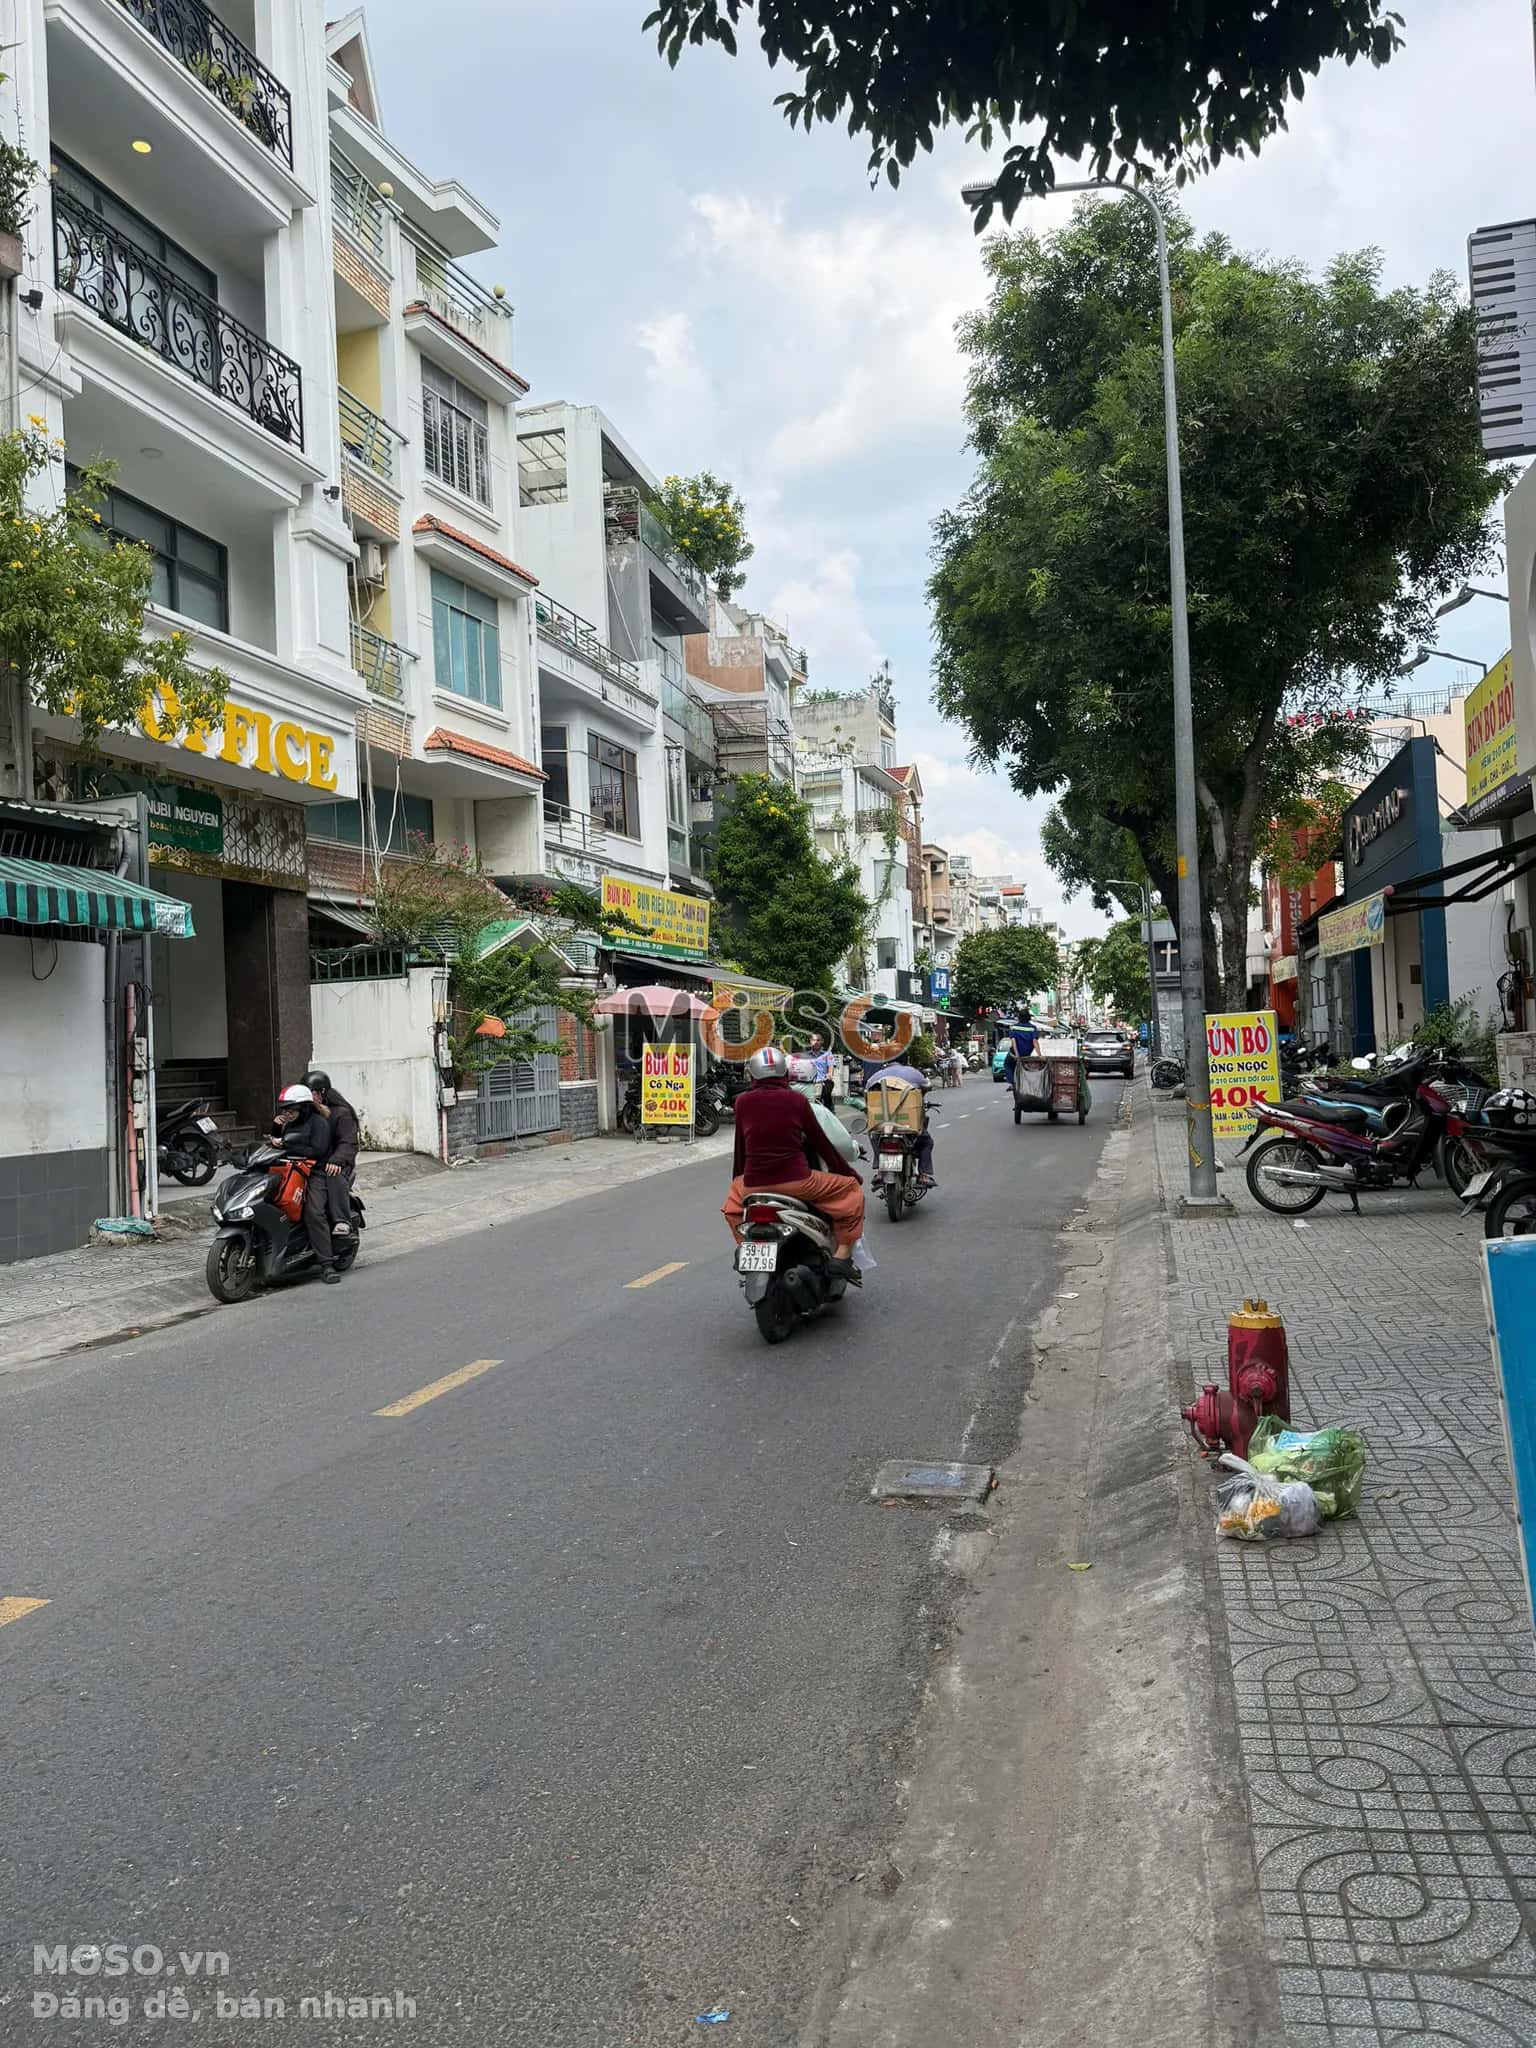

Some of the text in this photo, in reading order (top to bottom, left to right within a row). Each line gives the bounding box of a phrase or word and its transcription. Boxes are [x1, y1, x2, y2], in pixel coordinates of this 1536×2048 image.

[1208, 1020, 1236, 1056] ÚN
[1241, 1016, 1269, 1054] BÒ
[1236, 1060, 1268, 1073] NGỌC
[665, 1080, 684, 1091] Nga
[659, 1099, 687, 1112] 40K
[740, 1257, 774, 1270] 217.96
